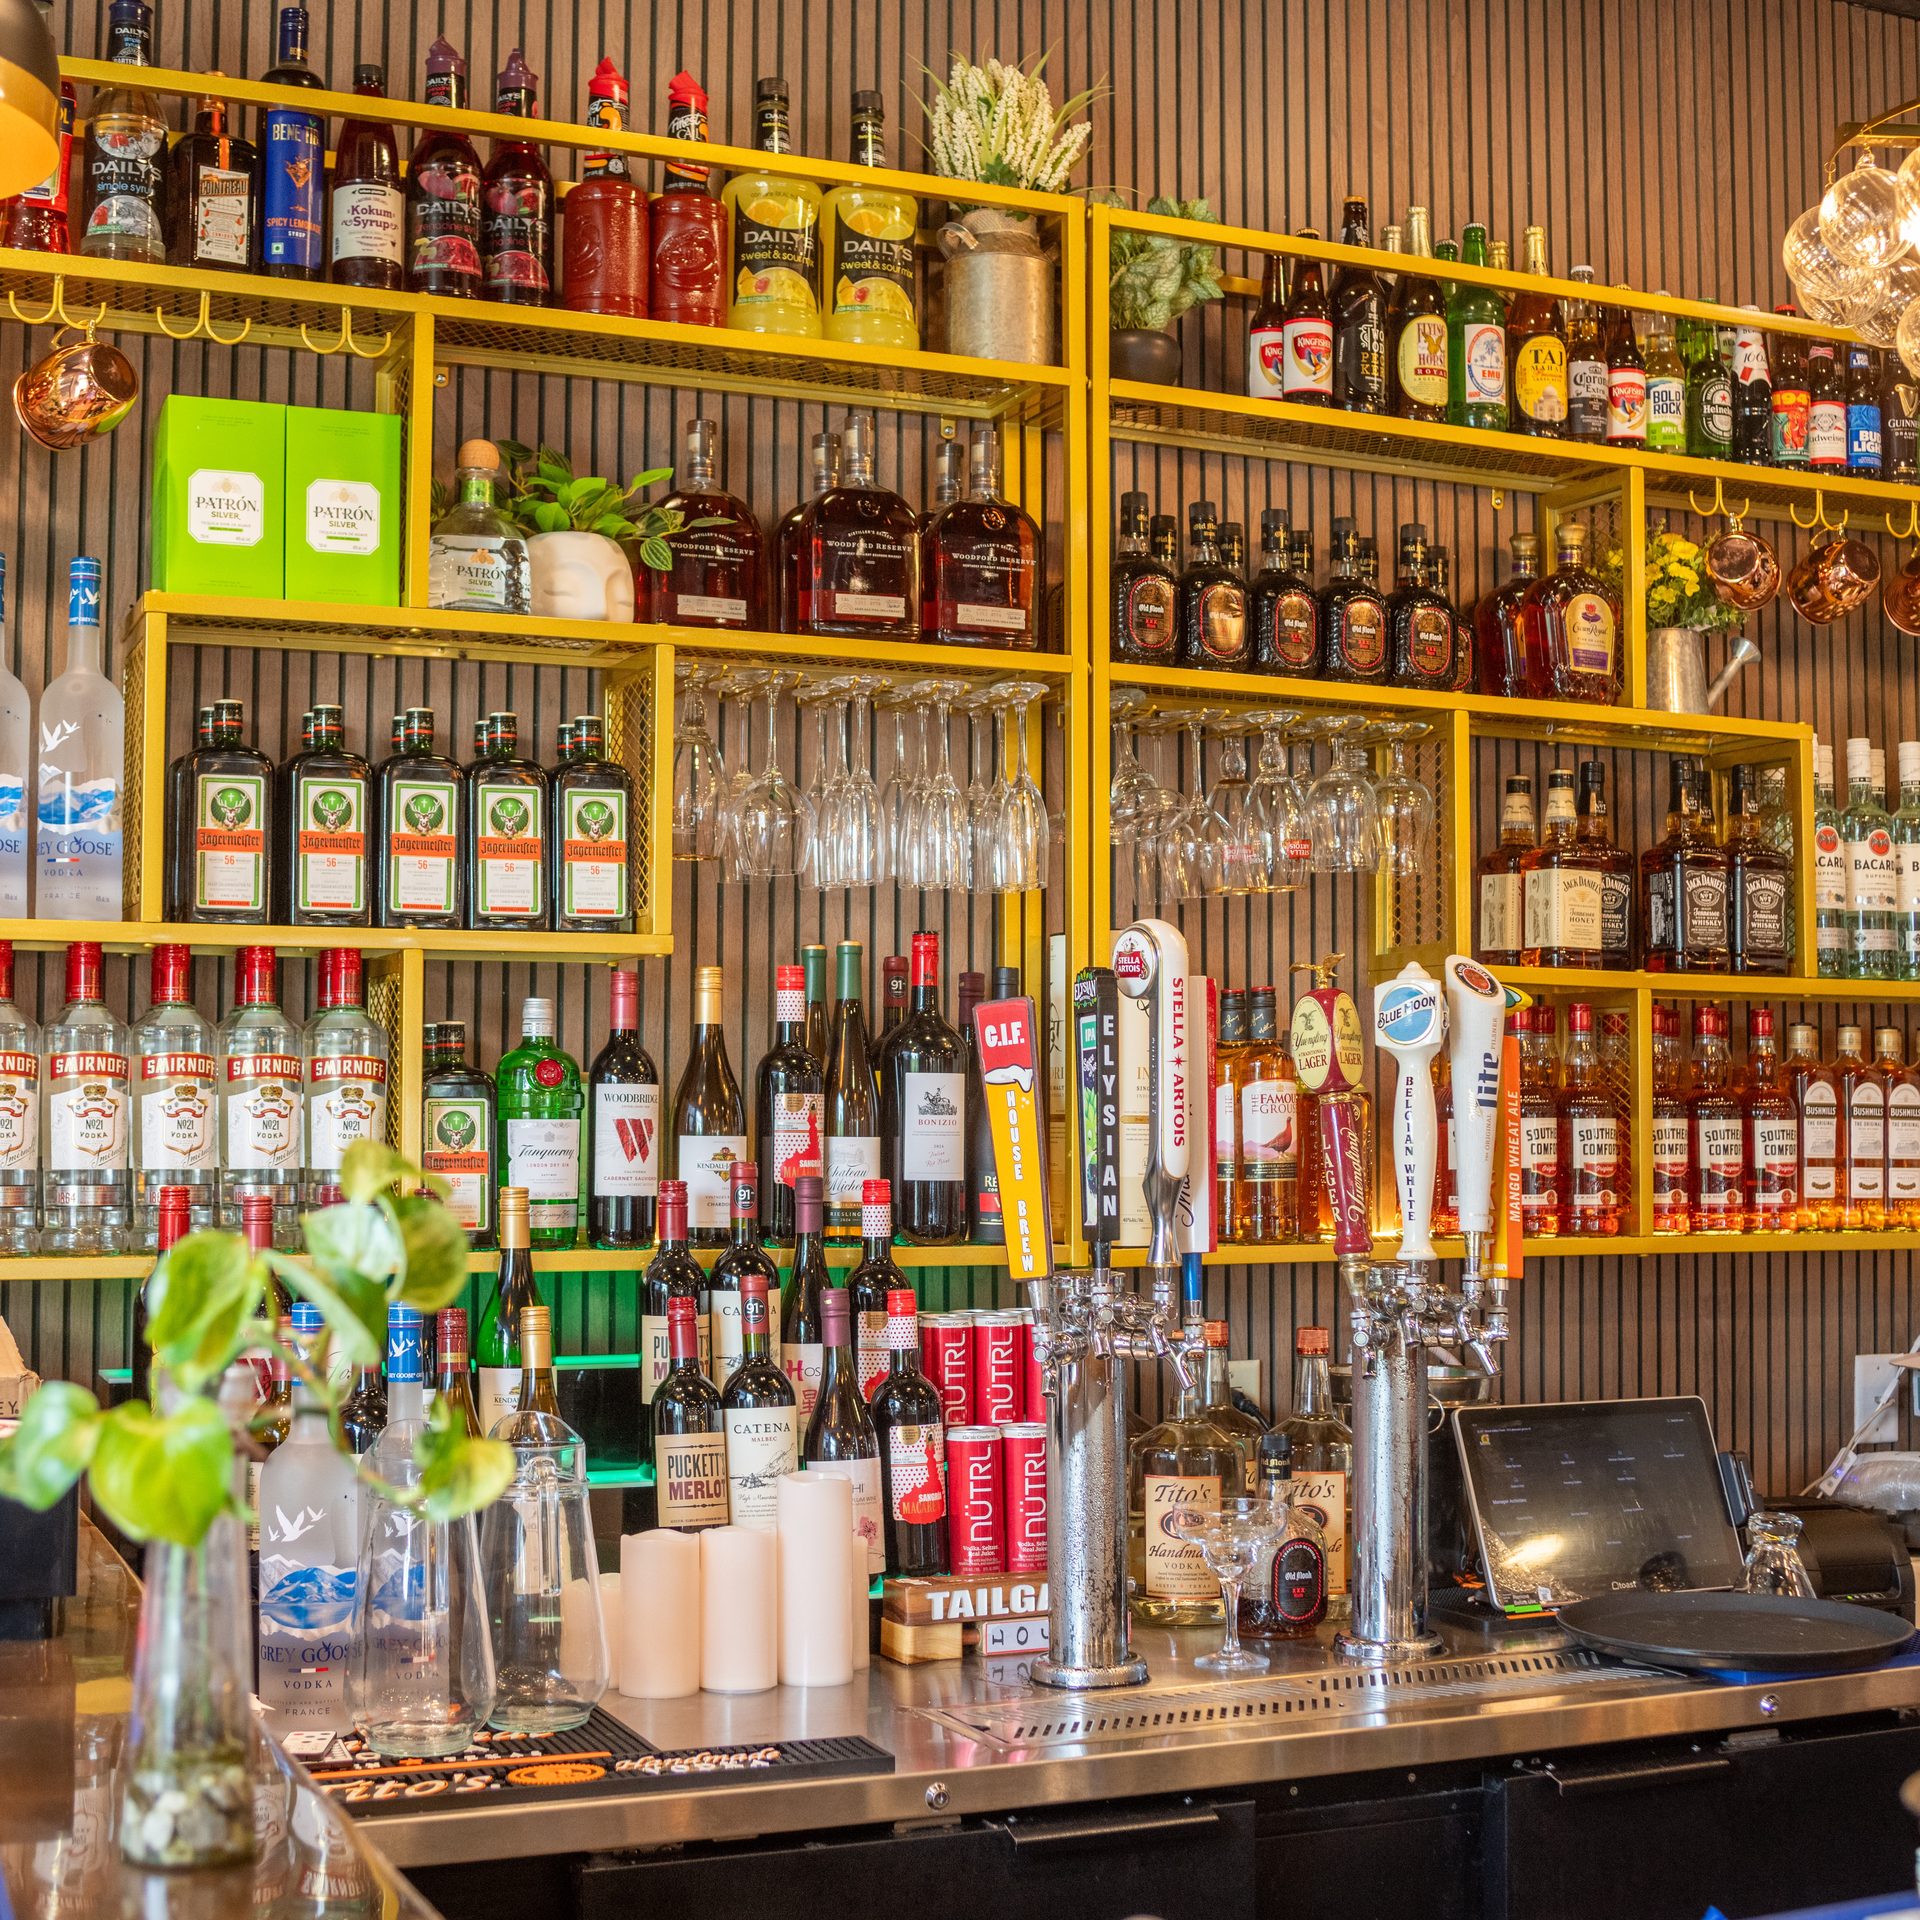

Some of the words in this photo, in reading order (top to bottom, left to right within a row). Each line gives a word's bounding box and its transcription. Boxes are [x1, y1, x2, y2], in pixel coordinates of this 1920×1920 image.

[92, 161, 162, 182] DAILY'S
[97, 182, 129, 192] simple
[201, 179, 247, 195] COINTREAU
[351, 205, 392, 218] Kokum
[416, 200, 481, 220] DAILY'S
[267, 218, 287, 228] SPICY
[353, 217, 390, 231] Syrup
[288, 230, 306, 238] SYRUP
[744, 230, 815, 250] DAILY'S
[741, 251, 771, 261] sweet
[772, 250, 781, 260] &
[782, 252, 801, 263] sour
[844, 240, 913, 261] DAILY'S
[841, 260, 872, 270] sweet
[872, 260, 881, 269] &
[882, 261, 901, 273] sour
[901, 266, 914, 279] mix
[1530, 348, 1563, 367] TAJ
[1482, 369, 1500, 380] EMU
[1653, 390, 1681, 403] BOLD
[1653, 402, 1682, 415] ROCK
[1661, 426, 1677, 434] APPLE
[196, 496, 257, 512] PATRÓN
[211, 511, 240, 521] SILVER
[313, 506, 374, 521] PATRÓN
[329, 520, 357, 529] SILVER
[669, 542, 716, 552] WOODFORD
[718, 546, 755, 556] RESERVE
[827, 540, 874, 550] WOODFORD
[876, 543, 913, 552] RESERVE
[952, 553, 998, 562] WOODFORD
[1000, 556, 1037, 566] RESERVE
[456, 563, 507, 580] PATRÓN
[468, 578, 493, 588] SILVER
[224, 855, 235, 865] 56
[326, 857, 337, 868] 56
[418, 859, 428, 870] 56
[504, 862, 515, 873] 56
[1855, 859, 1894, 871] BACARD
[44, 869, 83, 877] VODKA
[590, 865, 600, 875] 56
[1563, 878, 1579, 892] JACK
[1578, 875, 1602, 895] DANIEL'S
[1605, 877, 1631, 896] DANIEL'S
[1686, 879, 1701, 892] JACK
[1701, 874, 1727, 893] DANIEL'S
[1746, 882, 1761, 895] JACK
[1761, 877, 1786, 897] DANIEL'S
[1569, 916, 1596, 924] HONEY
[1691, 919, 1722, 927] WHISKEY
[1751, 921, 1780, 929] WHISKEY
[1118, 956, 1140, 965] STELLA
[1118, 964, 1141, 973] ARTOIS
[891, 980, 903, 990] 91
[1074, 979, 1097, 1001] ELYSIAN
[1172, 977, 1184, 1049] STELLA
[1377, 1007, 1402, 1029] BLUE
[1404, 995, 1436, 1016] MOON
[983, 1021, 1025, 1047] G.I.F.
[1085, 1027, 1096, 1042] IPA
[1292, 1030, 1329, 1051] Yuengling
[1335, 1026, 1361, 1046] Yuengling
[56, 1056, 128, 1075] SMIRNOFF
[147, 1056, 216, 1075] SMIRNOFF
[1300, 1054, 1328, 1071] LAGER
[1339, 1051, 1362, 1066] LAGER
[233, 1058, 300, 1076] SMIRNOFF
[315, 1059, 384, 1077] SMIRNOFF
[1477, 1052, 1500, 1108] lite
[604, 1092, 658, 1103] WOODBRIDG
[1224, 1094, 1233, 1115] THE
[1251, 1093, 1260, 1115] THE
[1260, 1093, 1297, 1104] FAMOU
[1507, 1091, 1519, 1116] ALE
[1102, 1014, 1118, 1216] ELYSIAN
[1173, 1073, 1185, 1148] ARTOIS
[1260, 1104, 1297, 1114] GROUS
[1404, 1076, 1414, 1156] BELGIAN
[1805, 1106, 1836, 1116] BUSHMILLS
[1853, 1106, 1884, 1117] BUSHMILLS
[171, 1131, 198, 1139] VODKA
[337, 1132, 364, 1140] VODKA
[1526, 1127, 1557, 1142] SOUTHE
[1579, 1127, 1616, 1142] SOUTHER
[1705, 1128, 1742, 1142] SOUTHE
[1760, 1128, 1797, 1143] SOUTHE
[1508, 1121, 1520, 1167] WHEAT
[517, 1144, 575, 1160] Tanqueray
[451, 1177, 461, 1187] 56
[1006, 1089, 1024, 1181] HOUSE
[1017, 1200, 1034, 1272] BREW
[1322, 1134, 1343, 1222] LAGER
[1340, 1127, 1366, 1222] Yuengling
[738, 1189, 750, 1200] 91
[1404, 1164, 1415, 1221] WHITE
[1509, 1173, 1521, 1223] MANGO
[746, 1302, 760, 1314] 91
[734, 1422, 791, 1434] CATENA
[669, 1480, 726, 1500] MERLOT
[1155, 1484, 1211, 1503] Tito's
[1149, 1543, 1204, 1558] Handma
[1165, 1562, 1201, 1570] VODKA
[1285, 1572, 1296, 1580] Old
[1297, 1571, 1312, 1580] Monk
[1618, 1580, 1636, 1590] toast
[926, 1583, 1048, 1620] TAILGA
[260, 1644, 295, 1662] GREY
[284, 1680, 333, 1689] VODKA
[285, 1707, 331, 1716] FRANCE
